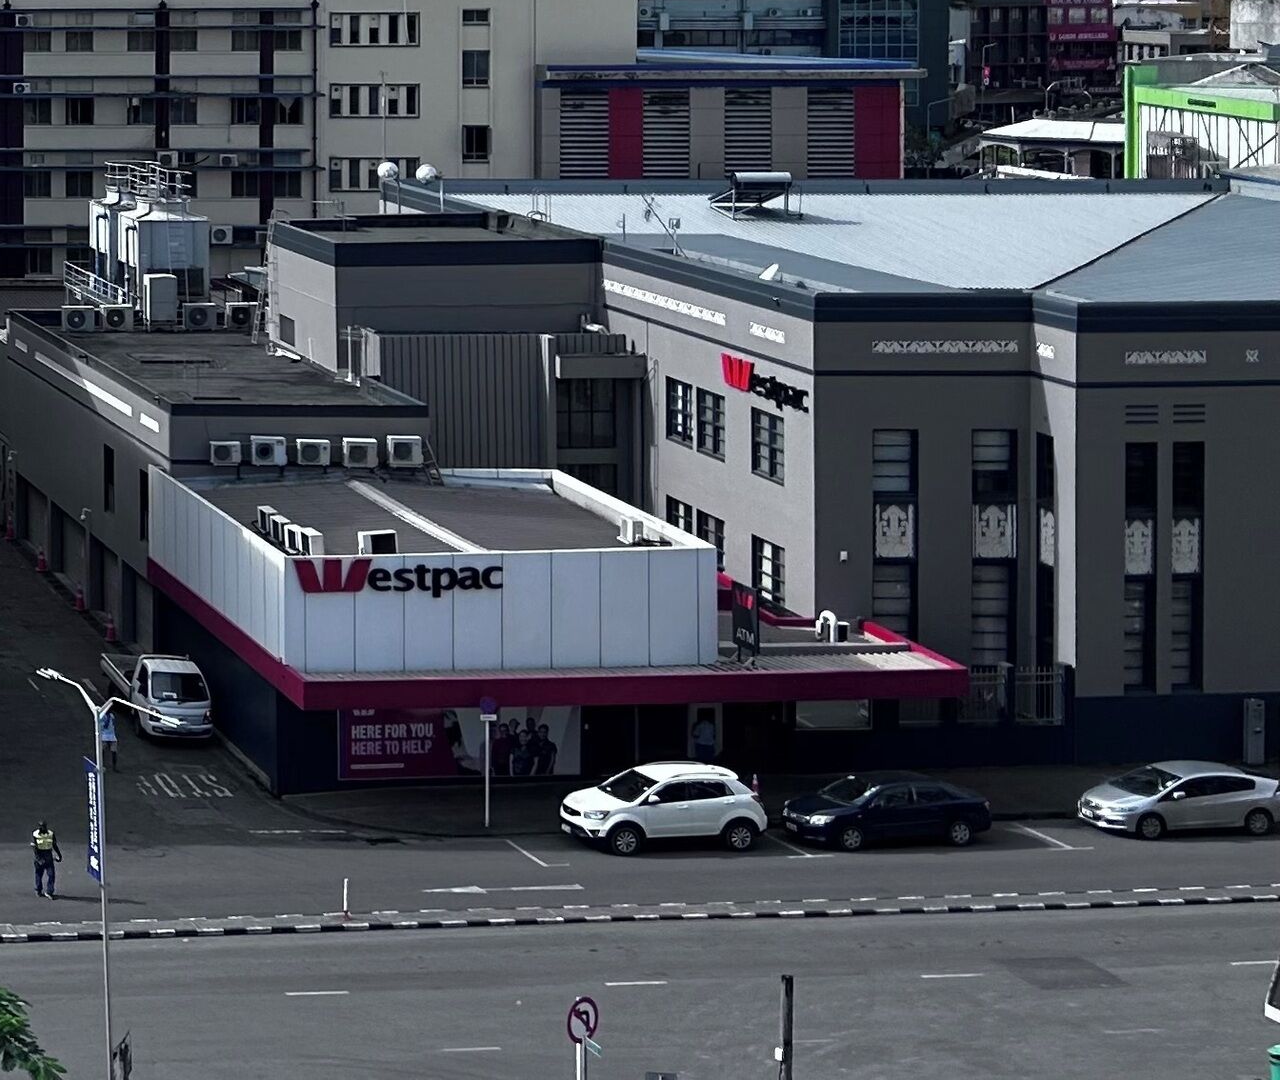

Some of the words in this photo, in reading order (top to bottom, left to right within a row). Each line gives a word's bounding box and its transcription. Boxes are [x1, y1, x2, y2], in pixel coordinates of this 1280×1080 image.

[721, 353, 809, 413] Westpac
[294, 558, 504, 598] Westpac
[736, 627, 755, 645] ATM
[351, 724, 382, 739] HERE
[384, 724, 408, 738] FOR
[351, 740, 382, 755] HERE
[384, 740, 400, 754] TO
[402, 740, 432, 754] HELP
